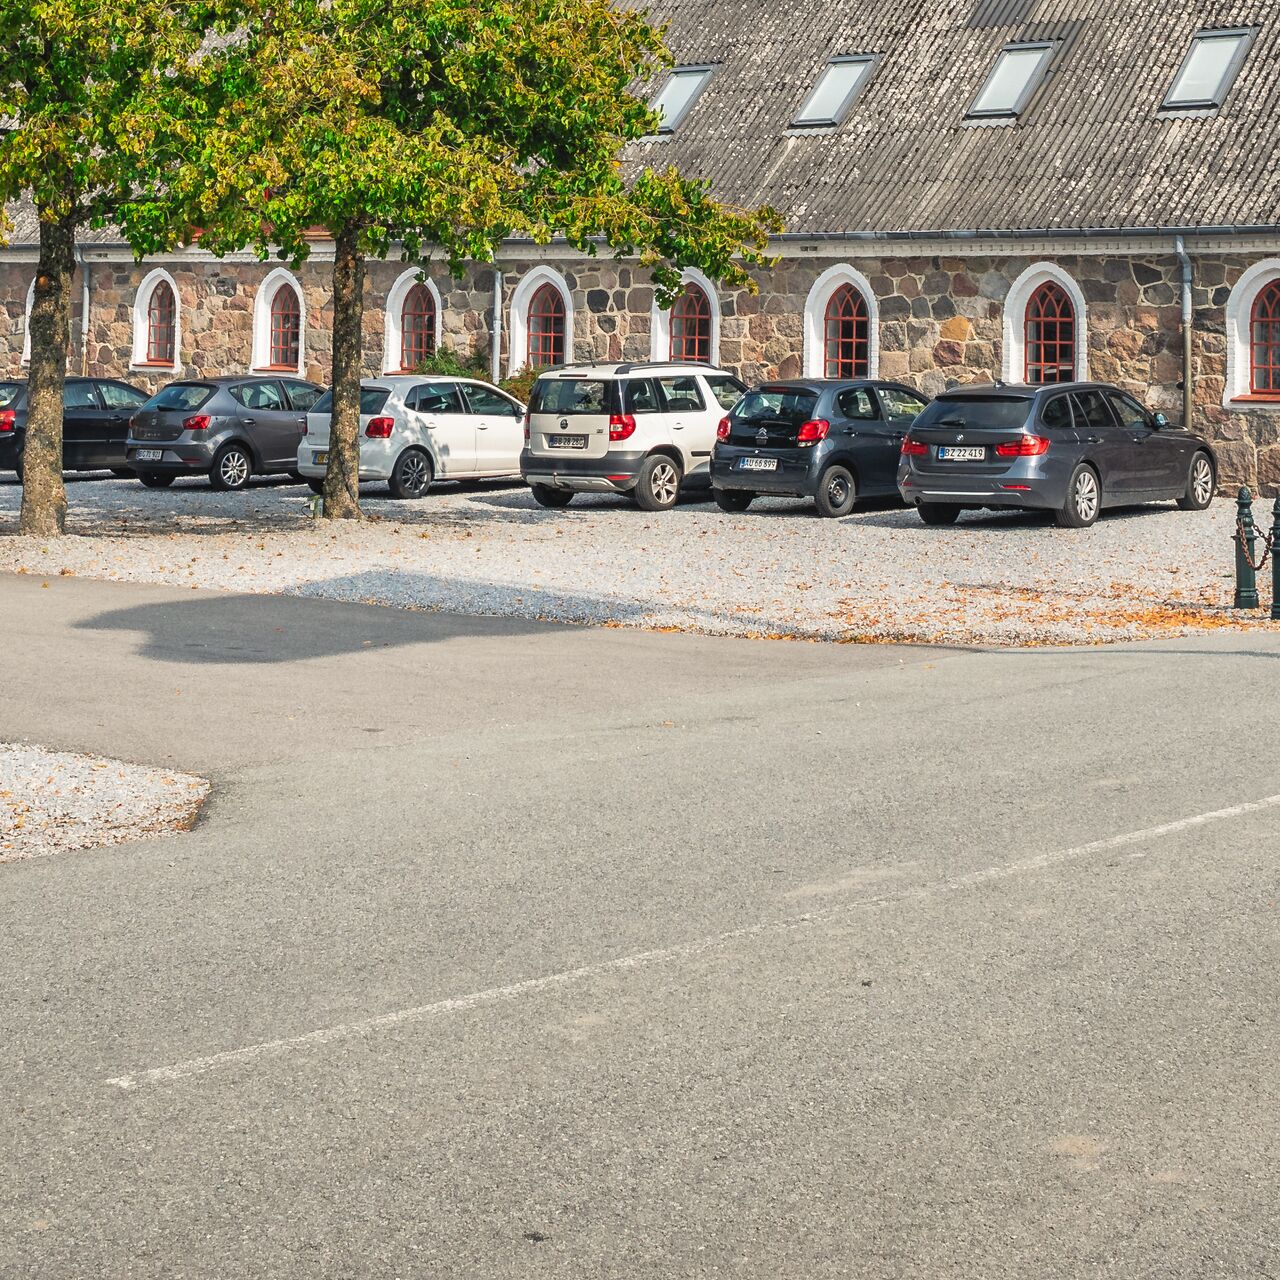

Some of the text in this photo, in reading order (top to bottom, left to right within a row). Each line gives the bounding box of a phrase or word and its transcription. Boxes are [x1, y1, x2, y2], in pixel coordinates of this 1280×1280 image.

[944, 448, 983, 458] BZ 22 419
[754, 458, 763, 468] 66
[763, 459, 776, 469] 899
